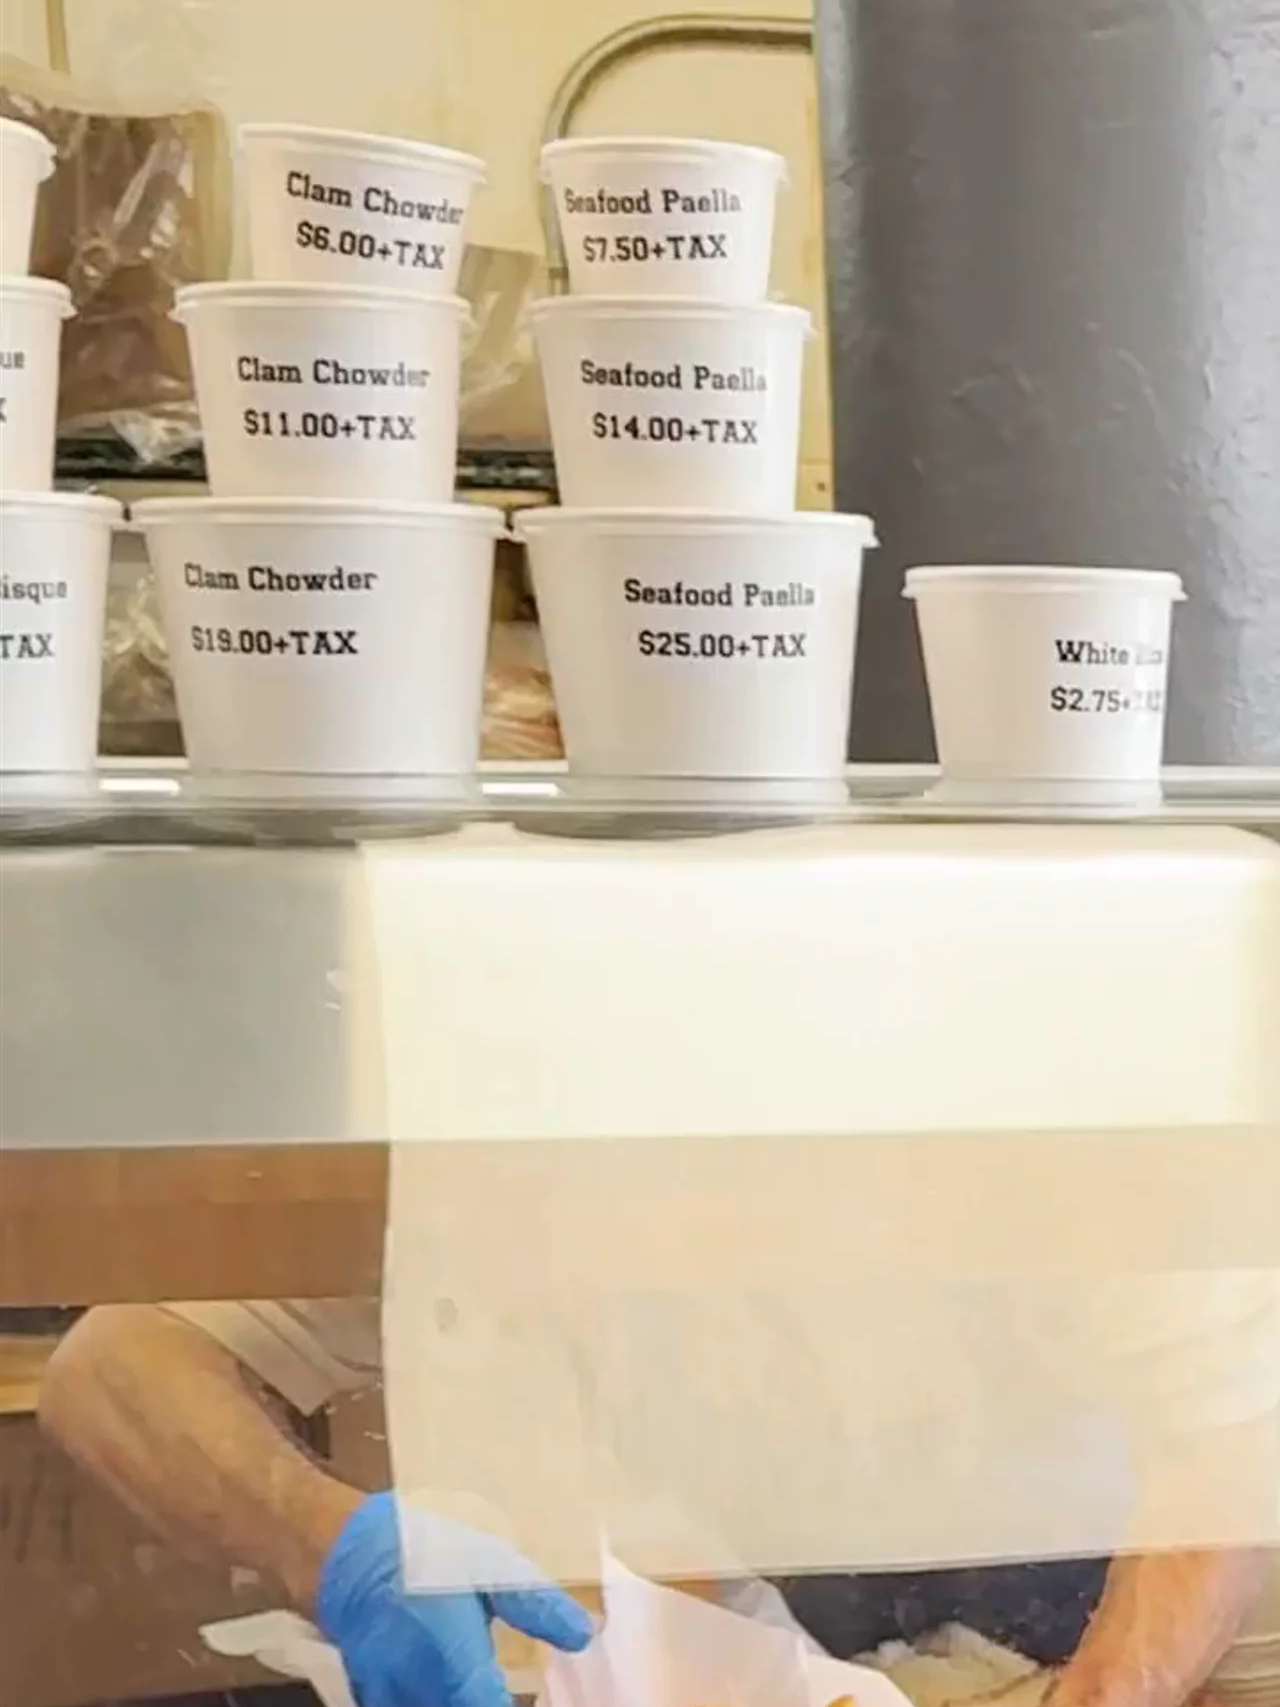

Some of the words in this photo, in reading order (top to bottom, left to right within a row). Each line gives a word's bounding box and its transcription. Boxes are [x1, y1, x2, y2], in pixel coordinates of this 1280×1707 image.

[286, 169, 353, 209] Clam
[363, 186, 465, 226] Chowder
[564, 186, 653, 215] Seafood
[661, 188, 742, 214] Paella
[296, 219, 445, 272] $6.00+TAX
[582, 233, 729, 264] $7.50+TAX
[237, 355, 304, 384] Clam
[312, 358, 431, 388] Chowder
[580, 358, 683, 390] Seafood
[693, 364, 768, 392] Paella
[243, 408, 417, 441] $11.00+TAX
[592, 411, 759, 444] $14.00+TAX
[0, 573, 68, 605] isque
[184, 562, 240, 591] Clam
[247, 565, 379, 592] Chowder
[624, 577, 734, 607] Seafood
[743, 581, 816, 608] Paella
[190, 624, 359, 656] $19.00+TAX
[638, 629, 807, 659] $25.00+TAX
[1054, 638, 1130, 665] White
